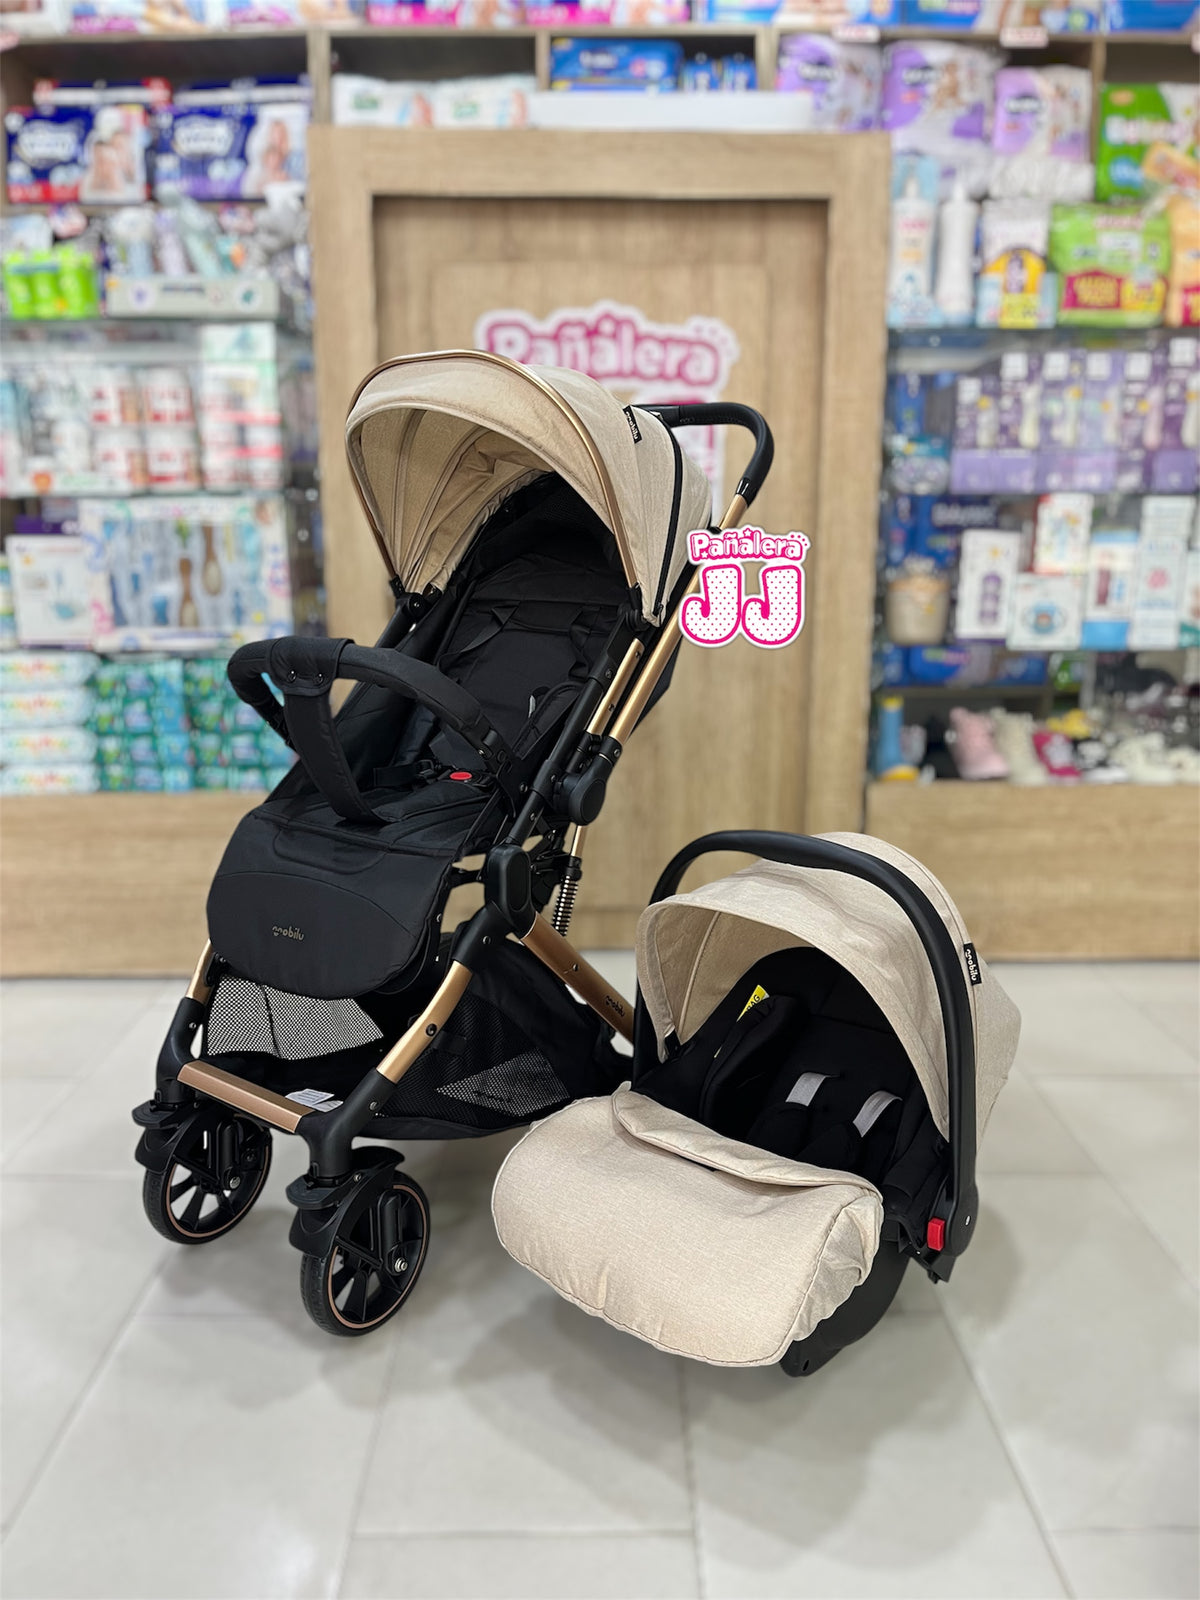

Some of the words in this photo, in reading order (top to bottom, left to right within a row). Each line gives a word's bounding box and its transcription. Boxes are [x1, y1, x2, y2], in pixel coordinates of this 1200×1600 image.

[487, 313, 719, 387] Pañalera
[272, 925, 305, 941] mobilu
[965, 948, 979, 981] mobilu
